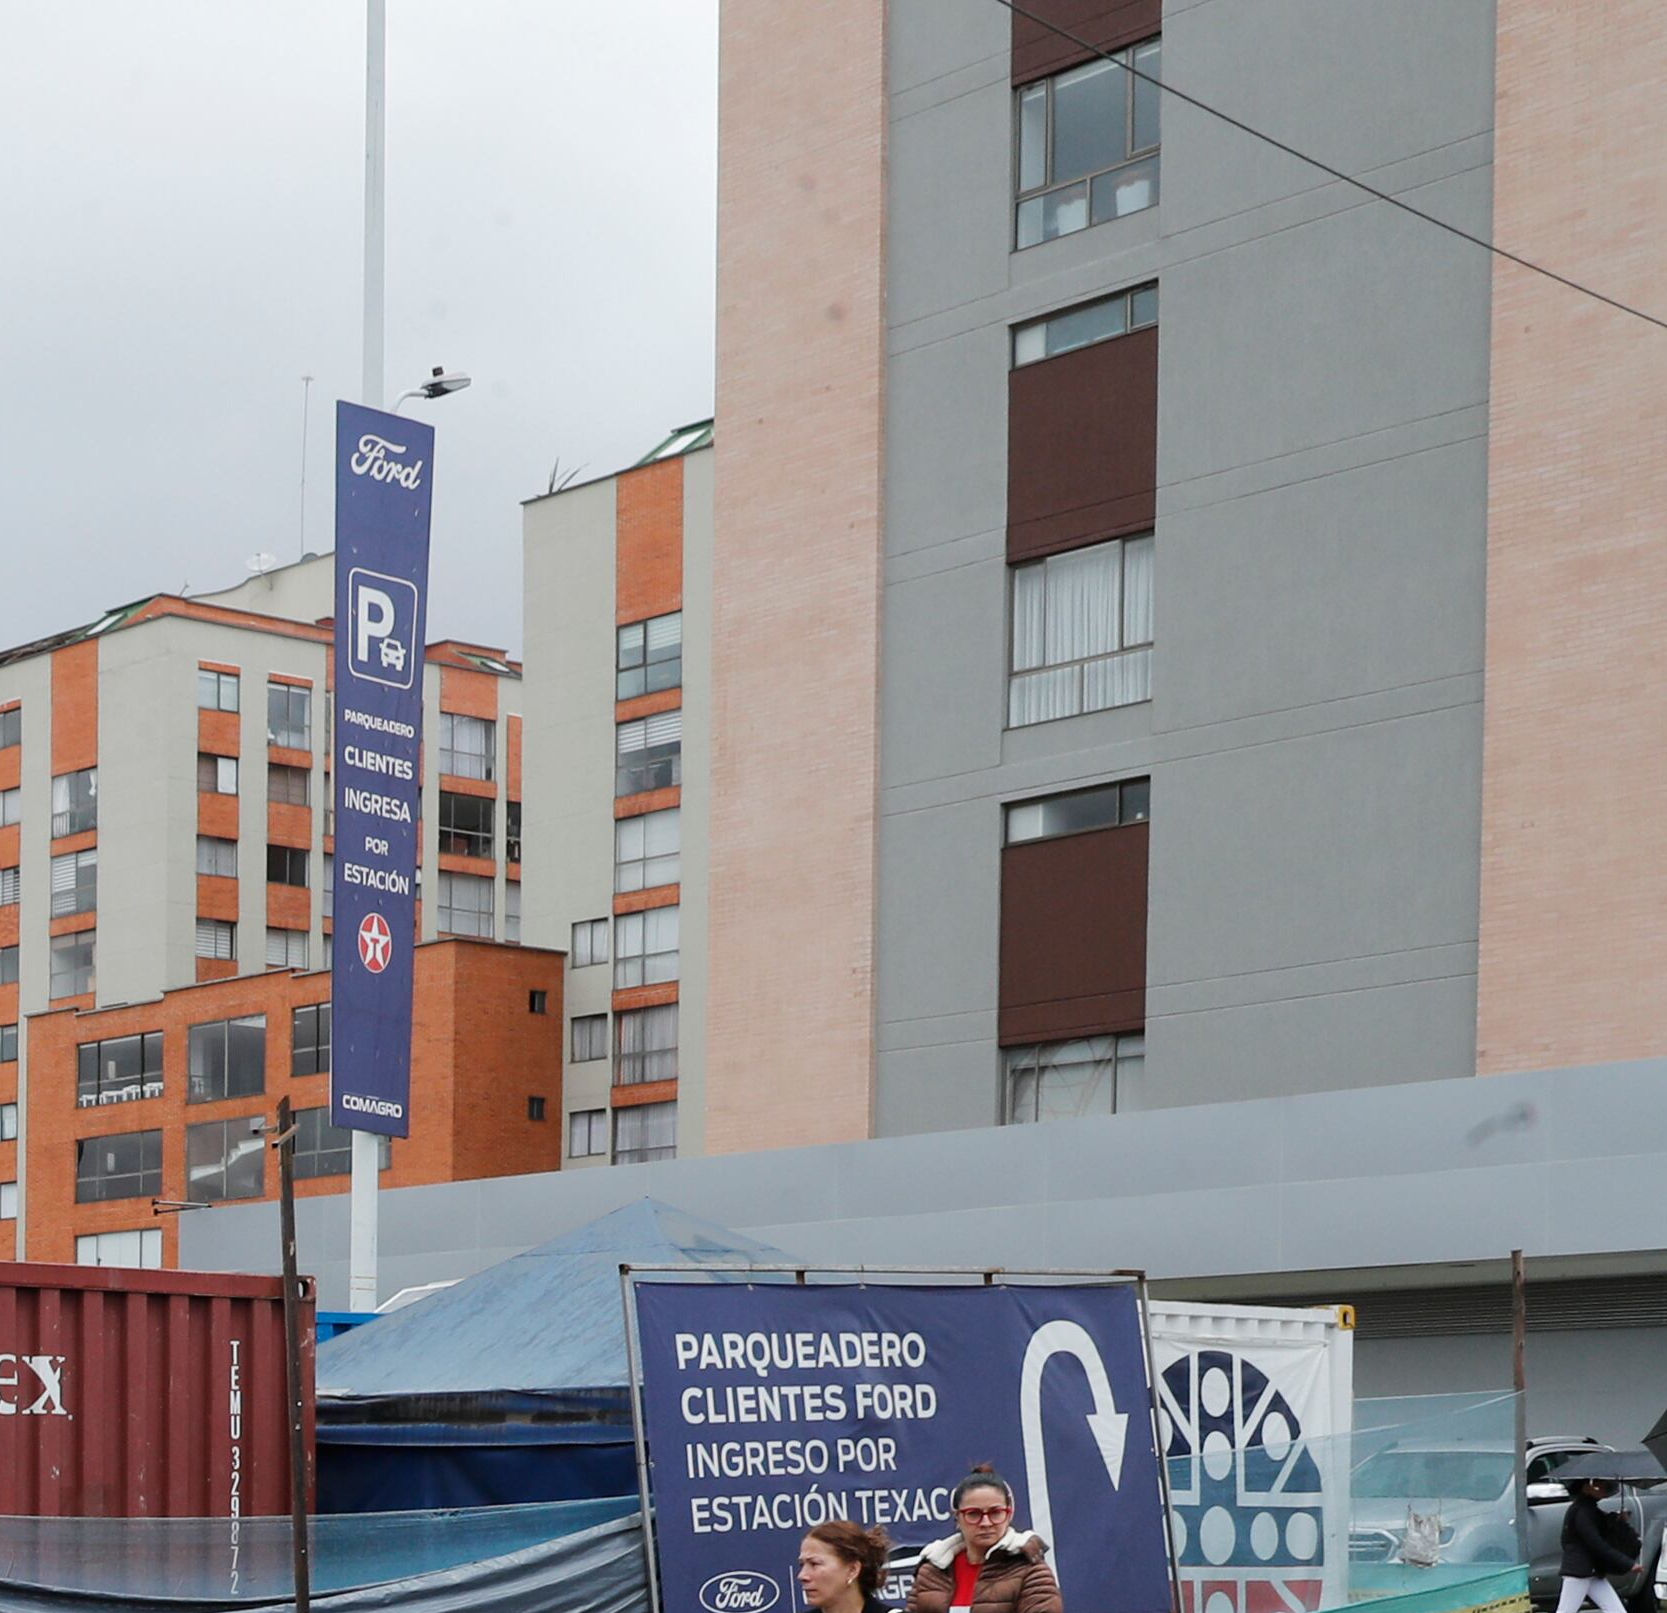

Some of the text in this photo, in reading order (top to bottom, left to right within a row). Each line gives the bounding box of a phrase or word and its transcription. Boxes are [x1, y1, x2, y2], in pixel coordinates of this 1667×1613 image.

[350, 434, 423, 490] Ford
[357, 584, 395, 663] P
[344, 708, 415, 739] PARQUEADERO
[344, 745, 413, 780] CLIENTES
[344, 786, 412, 823] INGRESA
[365, 836, 389, 857] POR
[344, 863, 409, 896] ESTACIÓN
[342, 1094, 403, 1118] COMAGRO
[675, 1332, 926, 1377] PARQUEADERO
[230, 1340, 242, 1440] TEMU
[681, 1383, 937, 1425] CLIENTES FORD
[686, 1437, 897, 1479] INGRESO POR
[691, 1483, 958, 1534] ESTACIÓN TEXAC
[715, 1577, 765, 1609] Ford
